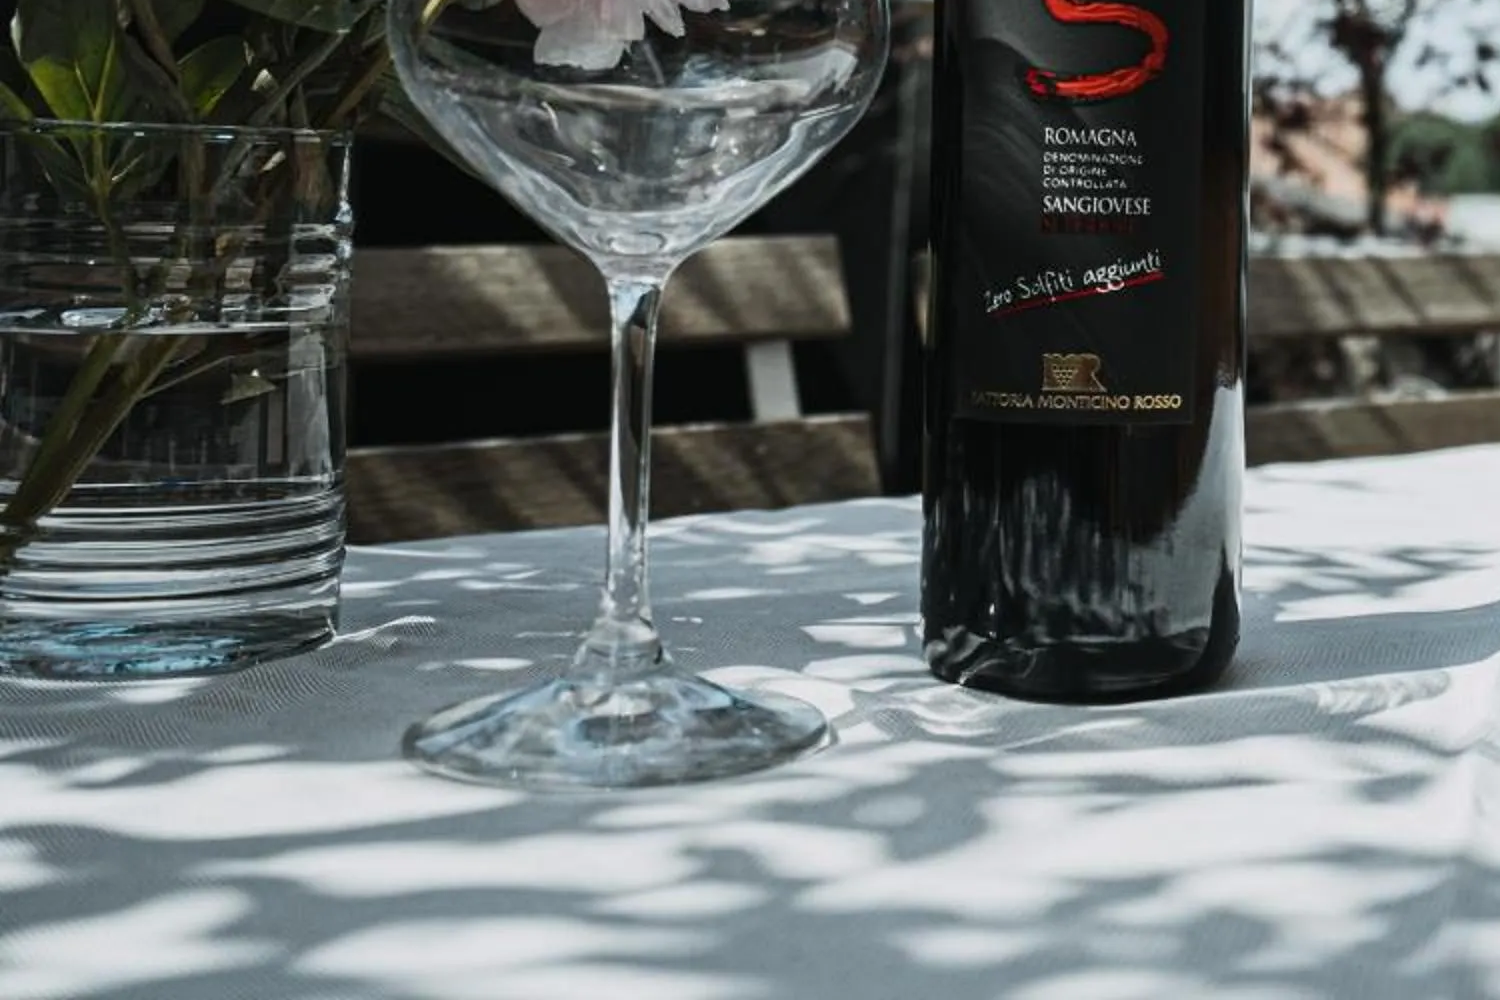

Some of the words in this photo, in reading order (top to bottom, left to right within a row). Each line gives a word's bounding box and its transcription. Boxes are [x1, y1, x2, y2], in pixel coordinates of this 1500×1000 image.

[1044, 126, 1138, 147] ROMAGNA
[1043, 151, 1145, 166] DENOMINAZIONE
[1059, 165, 1108, 178] ORIGINE
[1043, 177, 1128, 190] CONTROLLATA
[1043, 195, 1152, 216] SANGIOVESE
[1016, 268, 1076, 302] Solfiti
[1082, 248, 1163, 293] aggiunti
[1037, 393, 1130, 410] MONTICINO
[1133, 393, 1183, 410] ROSSO
